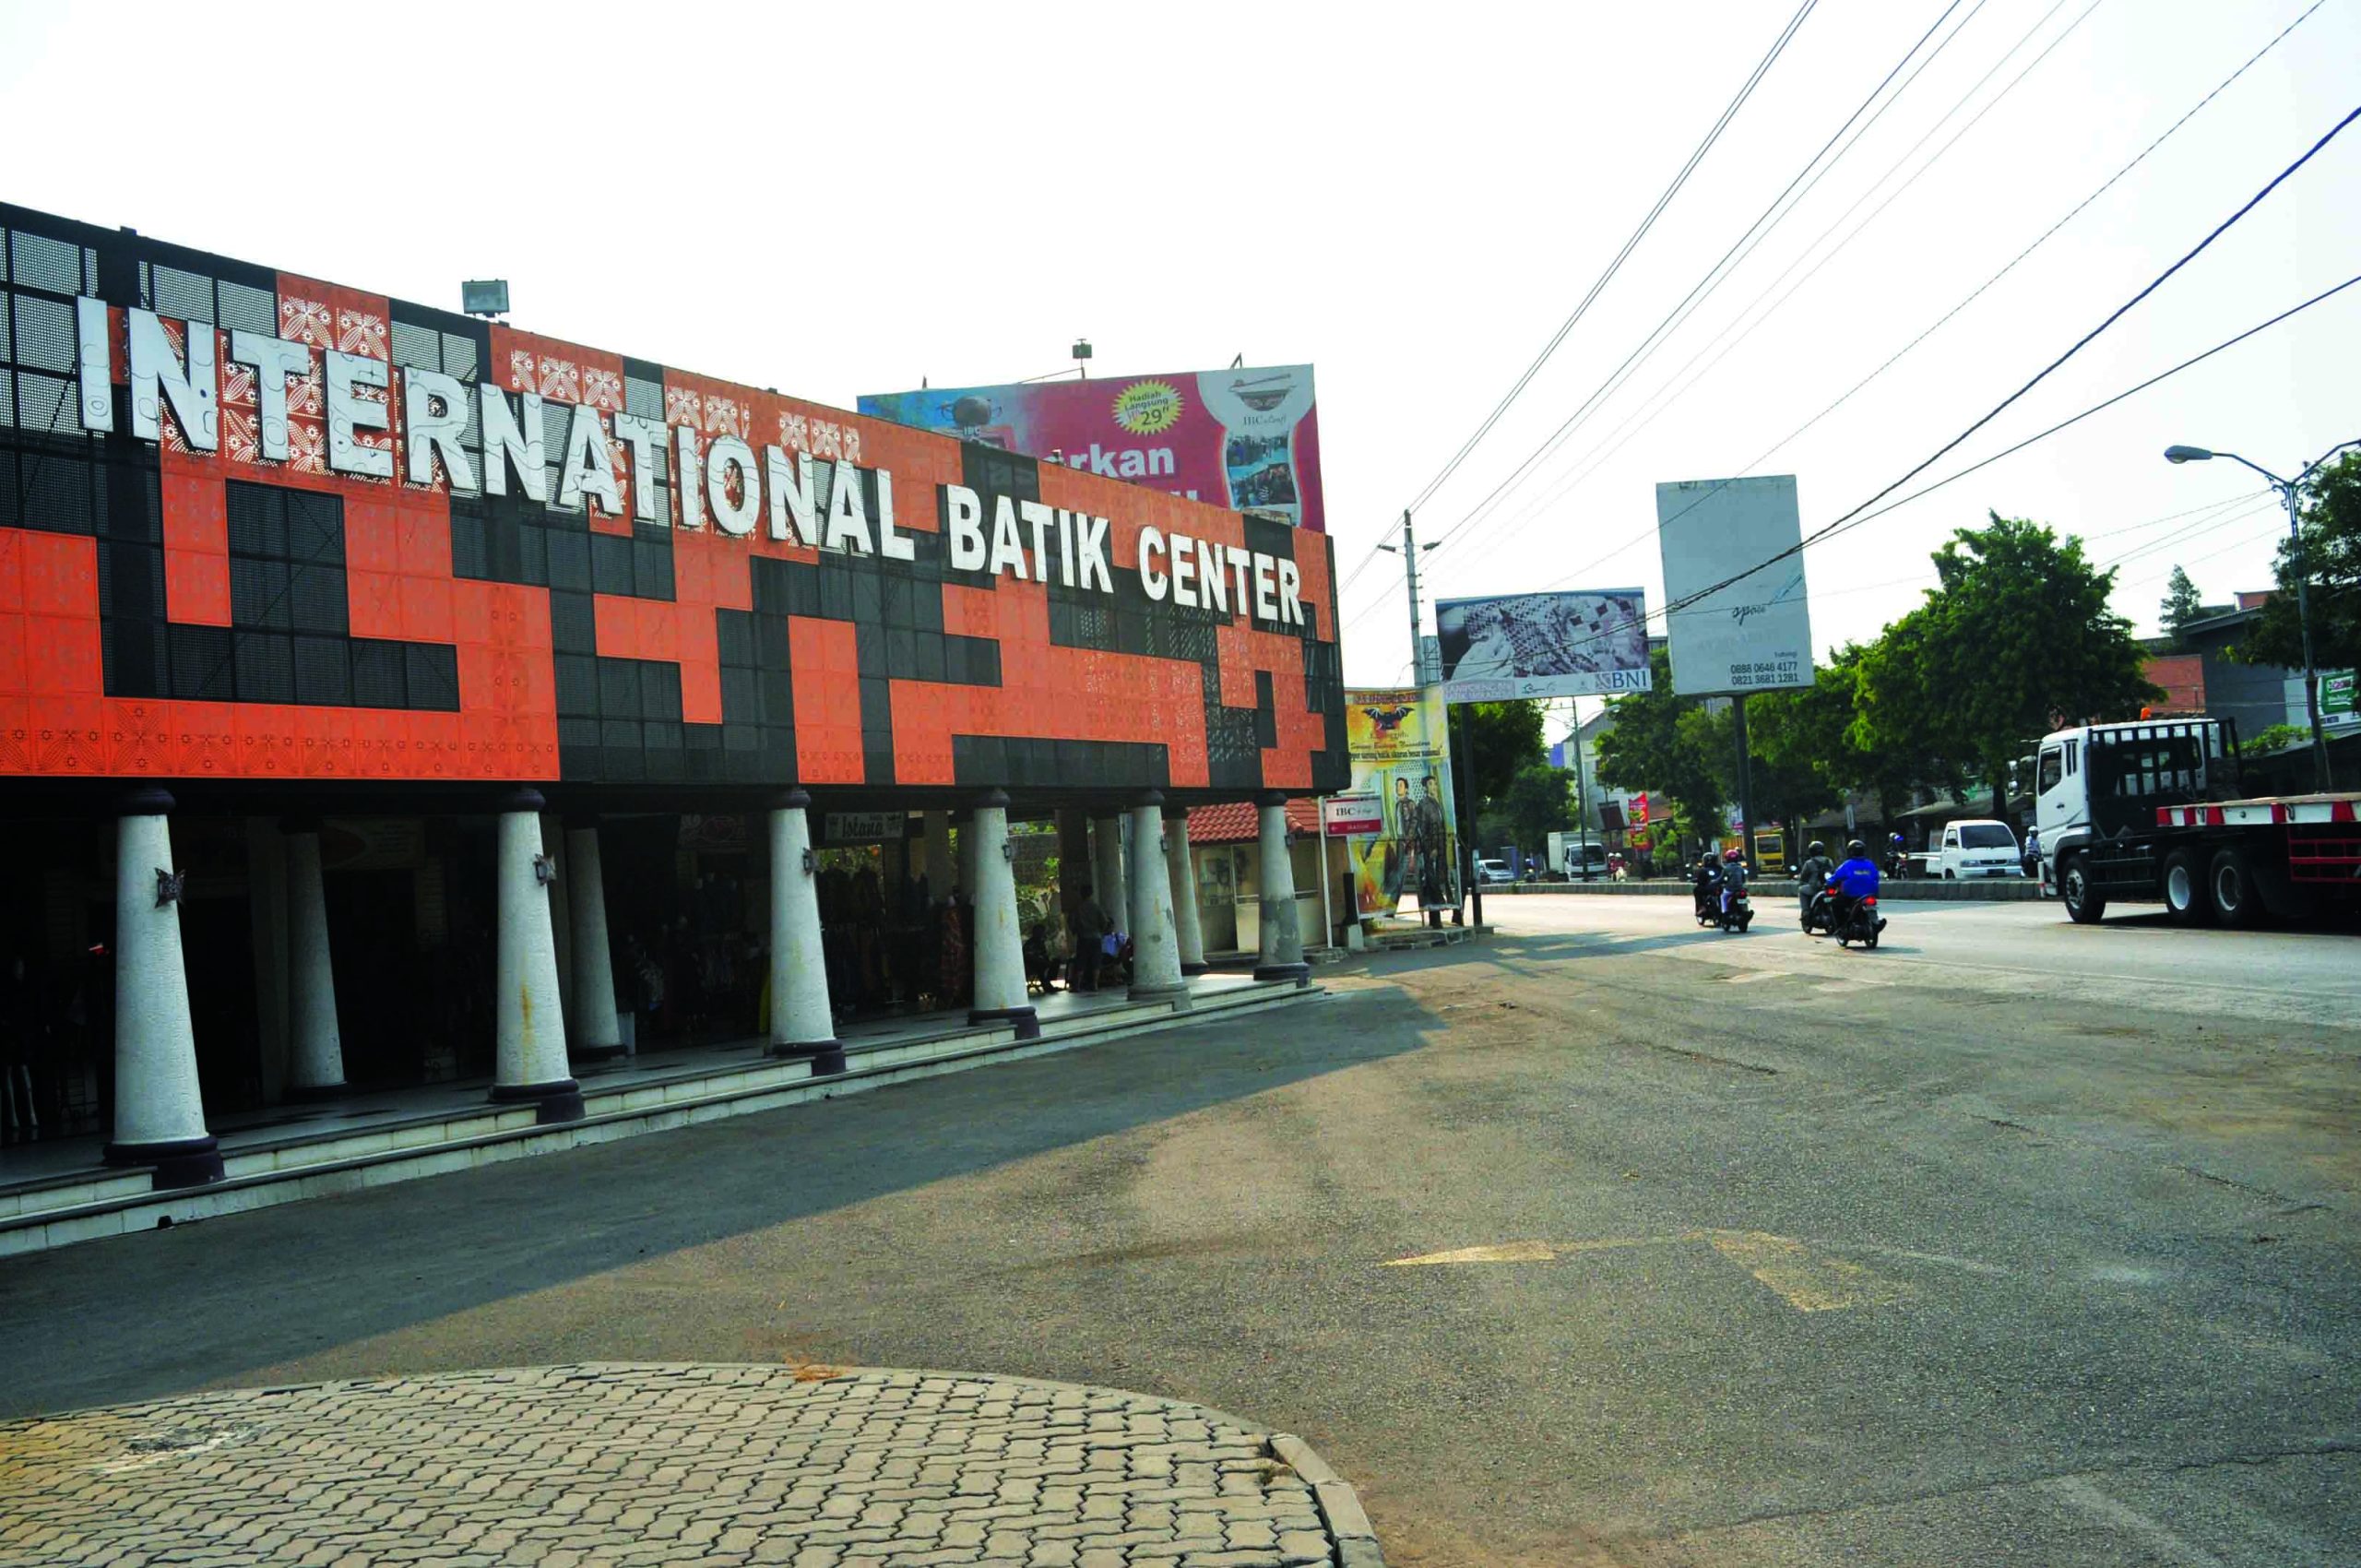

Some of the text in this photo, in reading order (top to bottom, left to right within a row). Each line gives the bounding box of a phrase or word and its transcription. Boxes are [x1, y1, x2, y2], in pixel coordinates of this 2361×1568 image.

[1129, 390, 1162, 402] Hadiah
[1124, 398, 1169, 411] Langsung
[77, 294, 1305, 625] INTERNATIONAL BATIK CENTER
[1776, 660, 1798, 671] 4177
[1612, 670, 1647, 689] BNI
[1335, 807, 1356, 816] IBC
[841, 815, 884, 838] Istana
